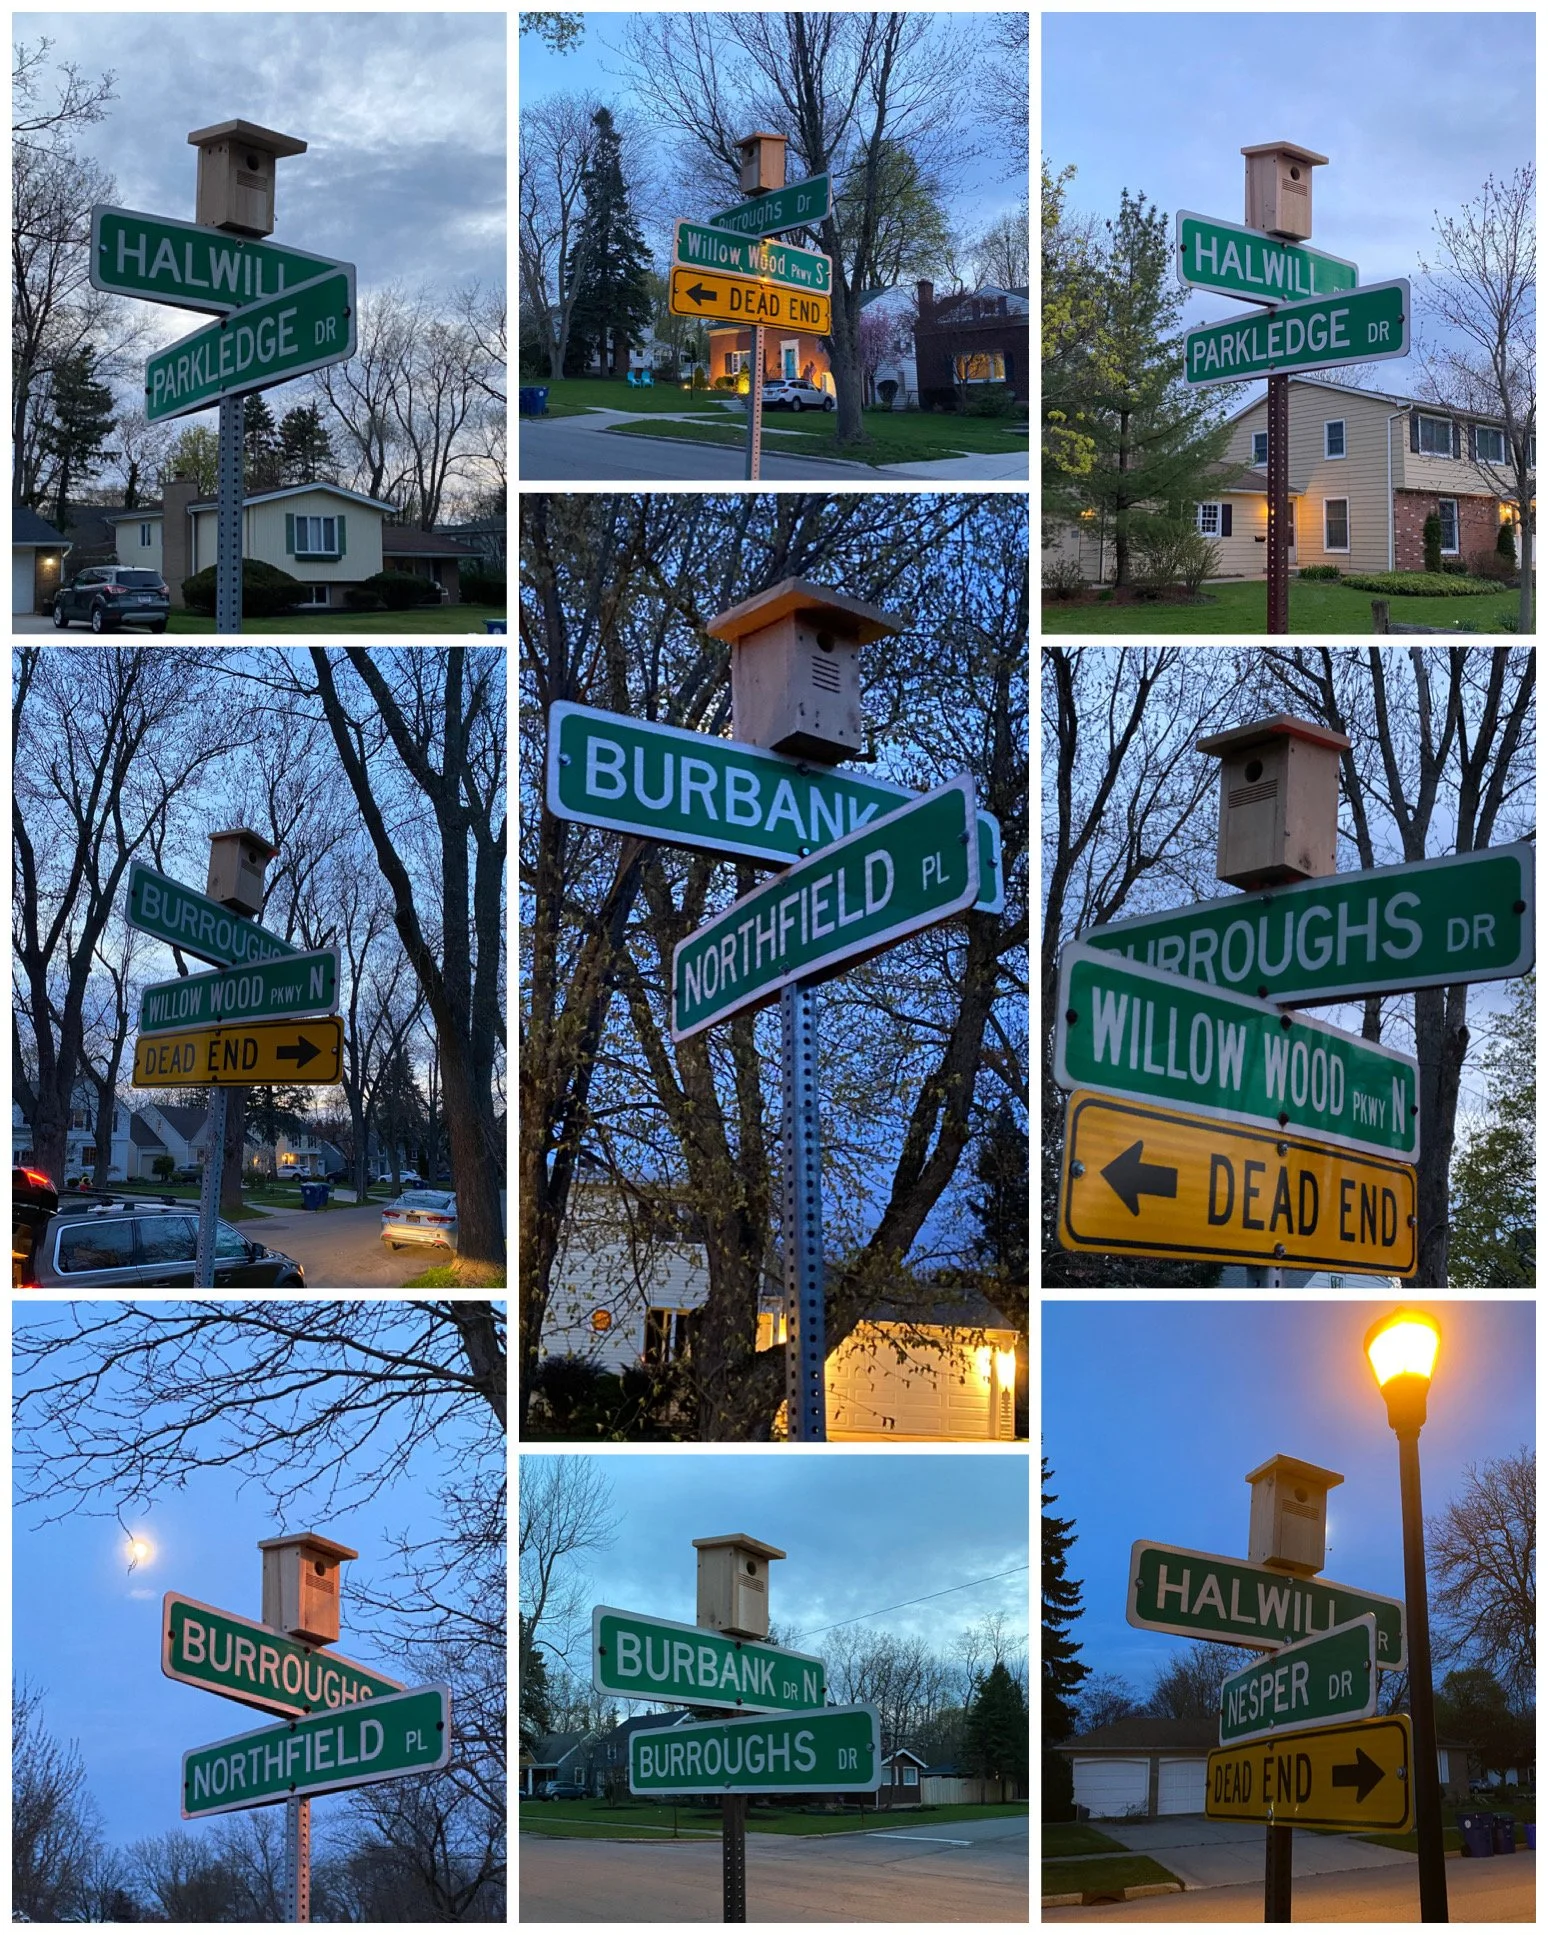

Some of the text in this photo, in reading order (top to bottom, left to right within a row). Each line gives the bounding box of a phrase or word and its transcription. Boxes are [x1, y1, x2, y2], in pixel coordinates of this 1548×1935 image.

[797, 195, 812, 213] Dr
[687, 231, 824, 285] Willow Wood Pkwy S
[1195, 232, 1323, 296] HALWILL
[730, 287, 820, 324] DEAD END
[153, 307, 336, 407] PARKLEDGE DR
[1193, 308, 1390, 374] PARKLEDGE DR
[684, 849, 950, 1013] NORTHFIELD PL
[1446, 913, 1496, 953] DR
[149, 965, 324, 1024] WILLOW WOOD PKWY N
[145, 1038, 258, 1075] DEAD END
[1091, 985, 1406, 1135] WILLOW WOOD PKWY N
[1207, 1153, 1398, 1248] DEAD END
[616, 1630, 817, 1703] BURBANK DR N
[1227, 1660, 1353, 1728] NESPER DR
[194, 1719, 428, 1800] NORTHFIELD PL
[640, 1730, 858, 1778] BURROUGHS DR
[1214, 1752, 1312, 1804] DEAD END
